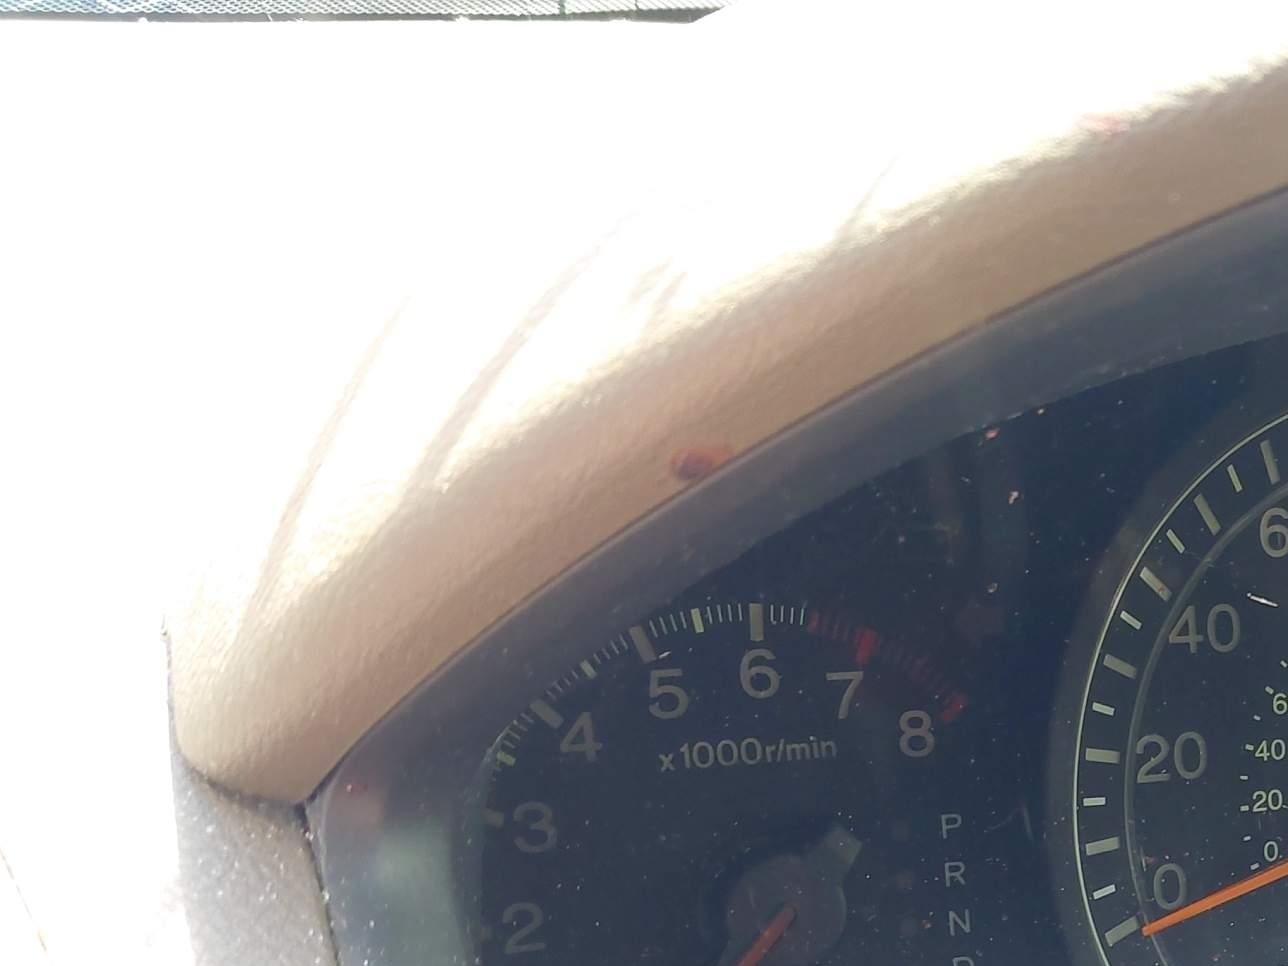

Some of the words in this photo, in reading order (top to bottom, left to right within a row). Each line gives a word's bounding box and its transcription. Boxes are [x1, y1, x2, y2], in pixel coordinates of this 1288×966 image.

[1169, 603, 1241, 653] 40
[648, 668, 689, 719] 5
[739, 649, 781, 699] 6
[826, 671, 864, 719] 7
[559, 712, 602, 762] 4
[899, 709, 935, 757] 8
[1136, 730, 1208, 784] 20
[1254, 739, 1286, 761] 40
[1252, 789, 1283, 813] 20
[512, 801, 558, 854] 3
[940, 813, 963, 839] P
[944, 862, 966, 887] R
[1263, 840, 1280, 862] 0
[1153, 862, 1188, 911] 0
[502, 902, 546, 954] 2
[948, 910, 972, 936] N
